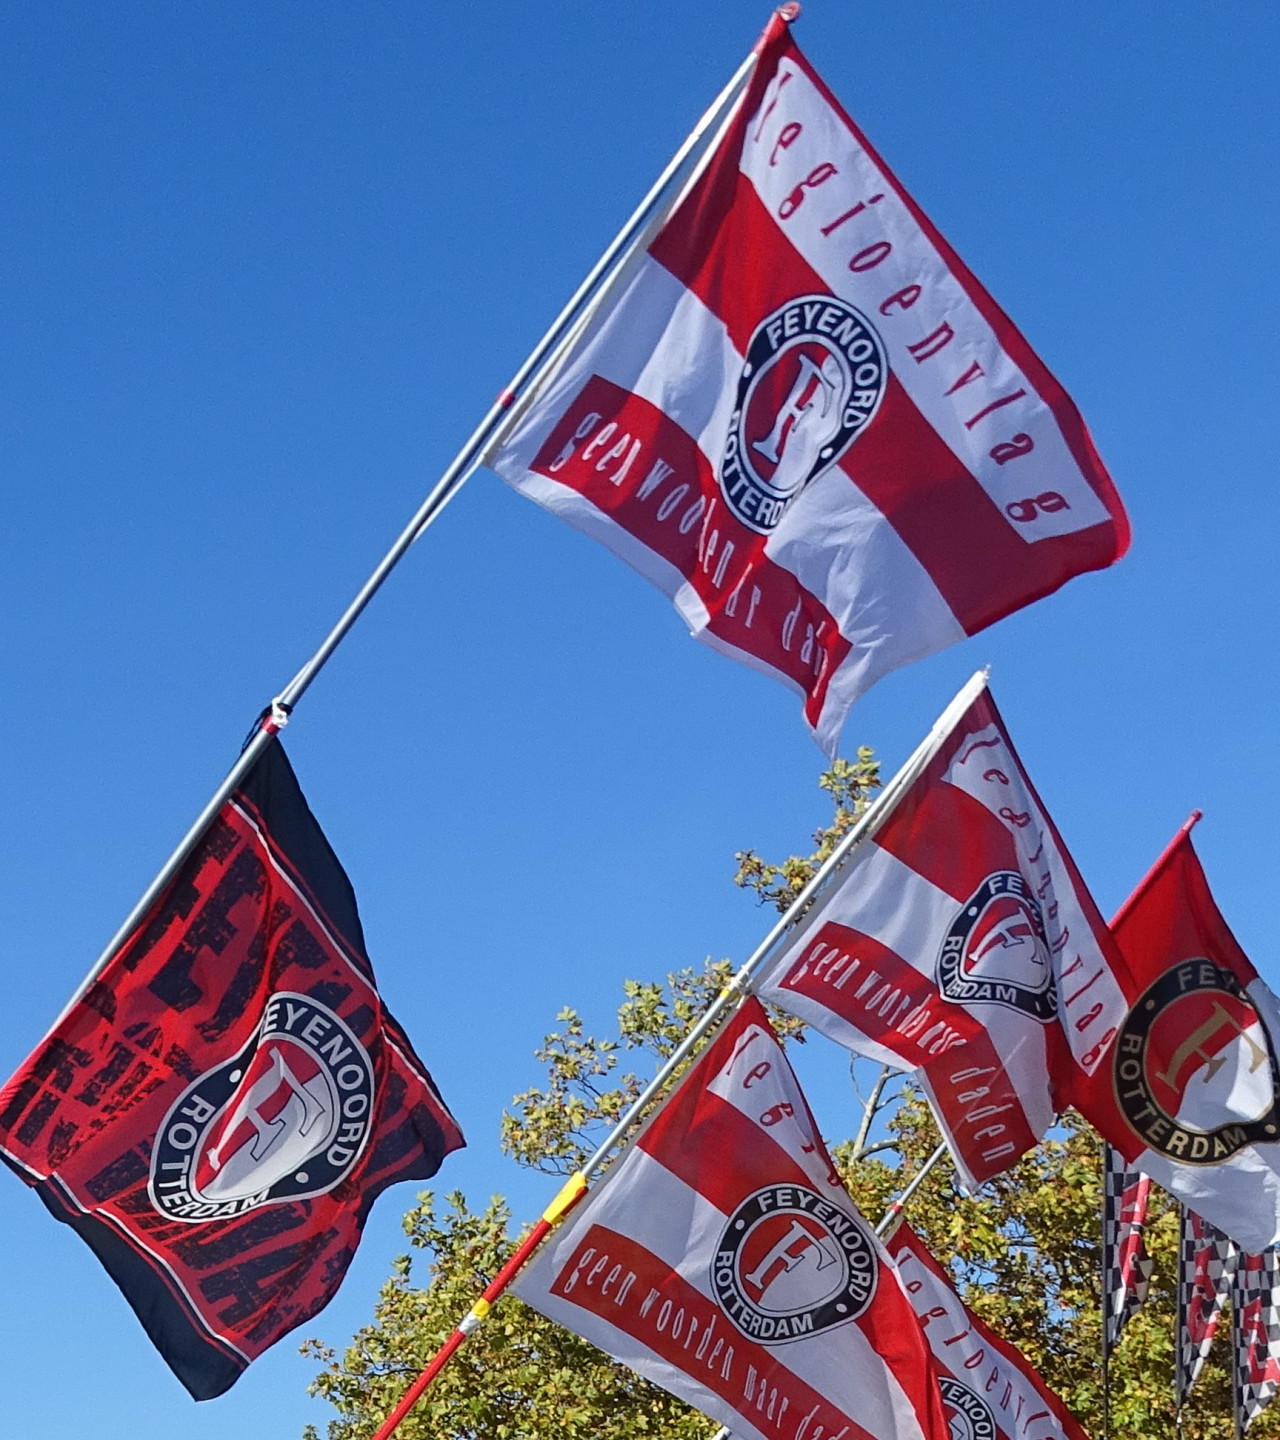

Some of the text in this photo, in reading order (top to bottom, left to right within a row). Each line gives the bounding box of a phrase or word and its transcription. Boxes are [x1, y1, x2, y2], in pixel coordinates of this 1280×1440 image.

[766, 304, 878, 429] FEYENOORD
[549, 412, 641, 487] geen
[942, 936, 1017, 1004] ROTDAM
[262, 1003, 369, 1167] EYENOORD
[789, 943, 860, 990] geen
[950, 1066, 1015, 1163] daden
[1121, 1033, 1248, 1159] ROTTERDAM
[159, 1095, 270, 1217] ROTTERDAM
[715, 1251, 814, 1338] ROTTERDAM
[758, 1189, 869, 1302] FEYENOORD
[564, 1248, 636, 1306] geen
[639, 1288, 734, 1381] woorden
[744, 1364, 790, 1428] maar
